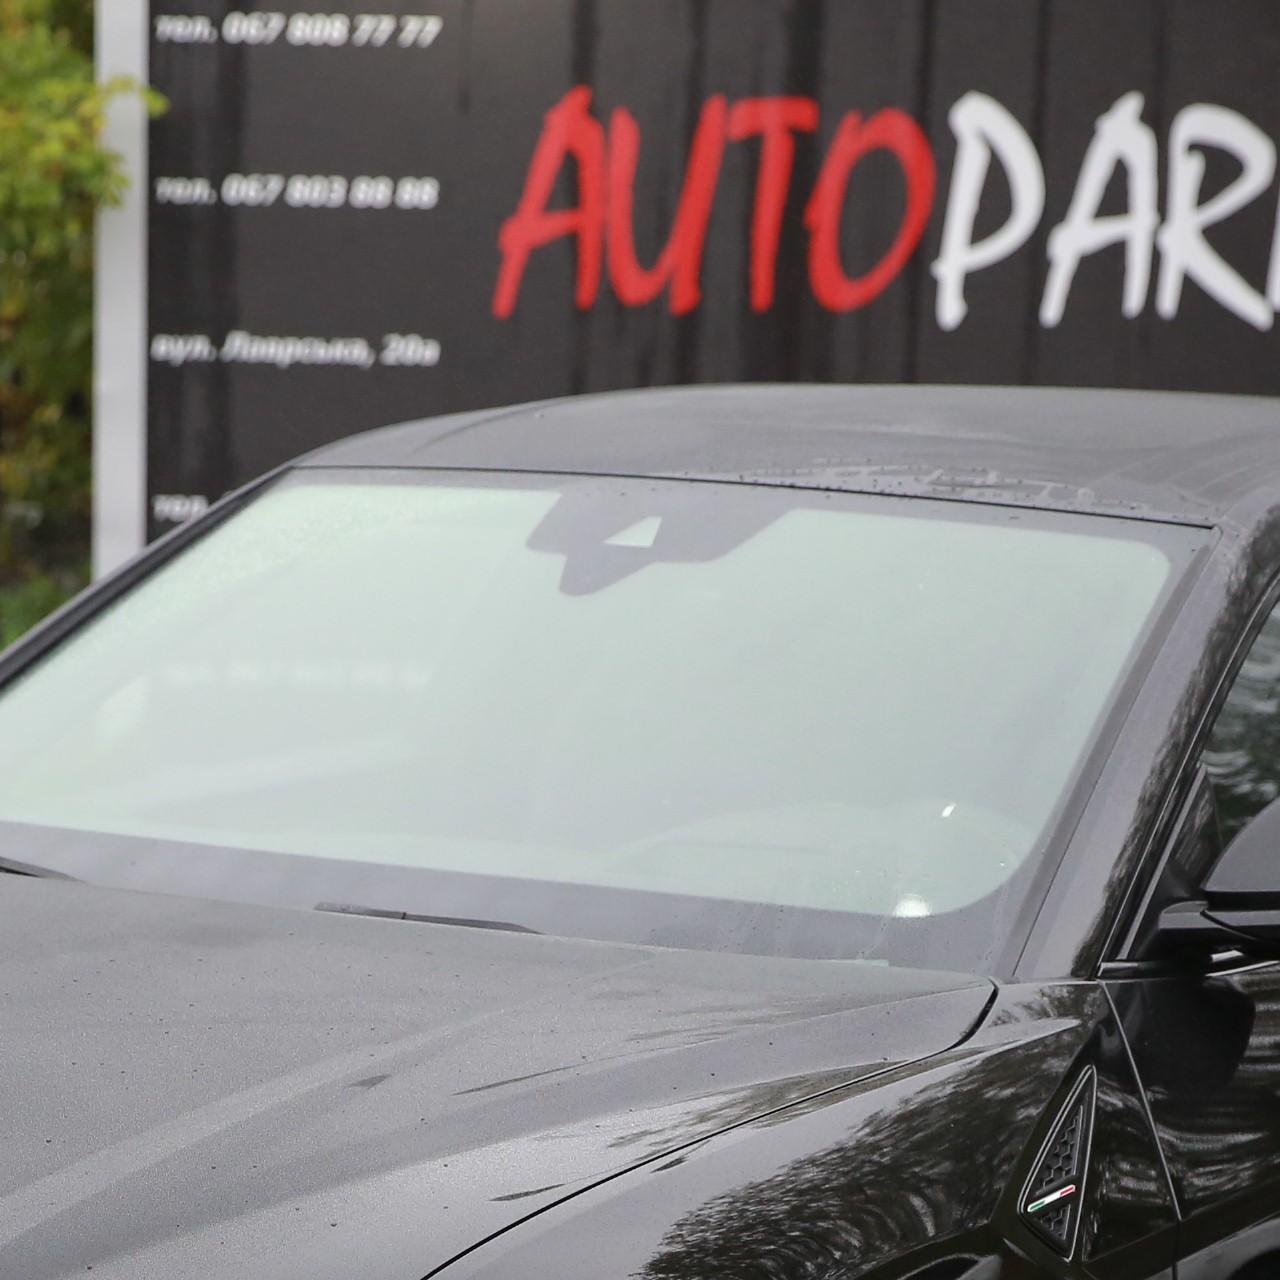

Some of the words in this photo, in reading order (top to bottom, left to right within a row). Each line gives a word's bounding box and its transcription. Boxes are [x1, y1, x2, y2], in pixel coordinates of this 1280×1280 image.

[221, 11, 286, 45] 067
[351, 14, 397, 47] 77
[398, 15, 443, 48] 77
[221, 173, 285, 207] 067
[348, 175, 394, 209] 88
[394, 176, 440, 210] 88
